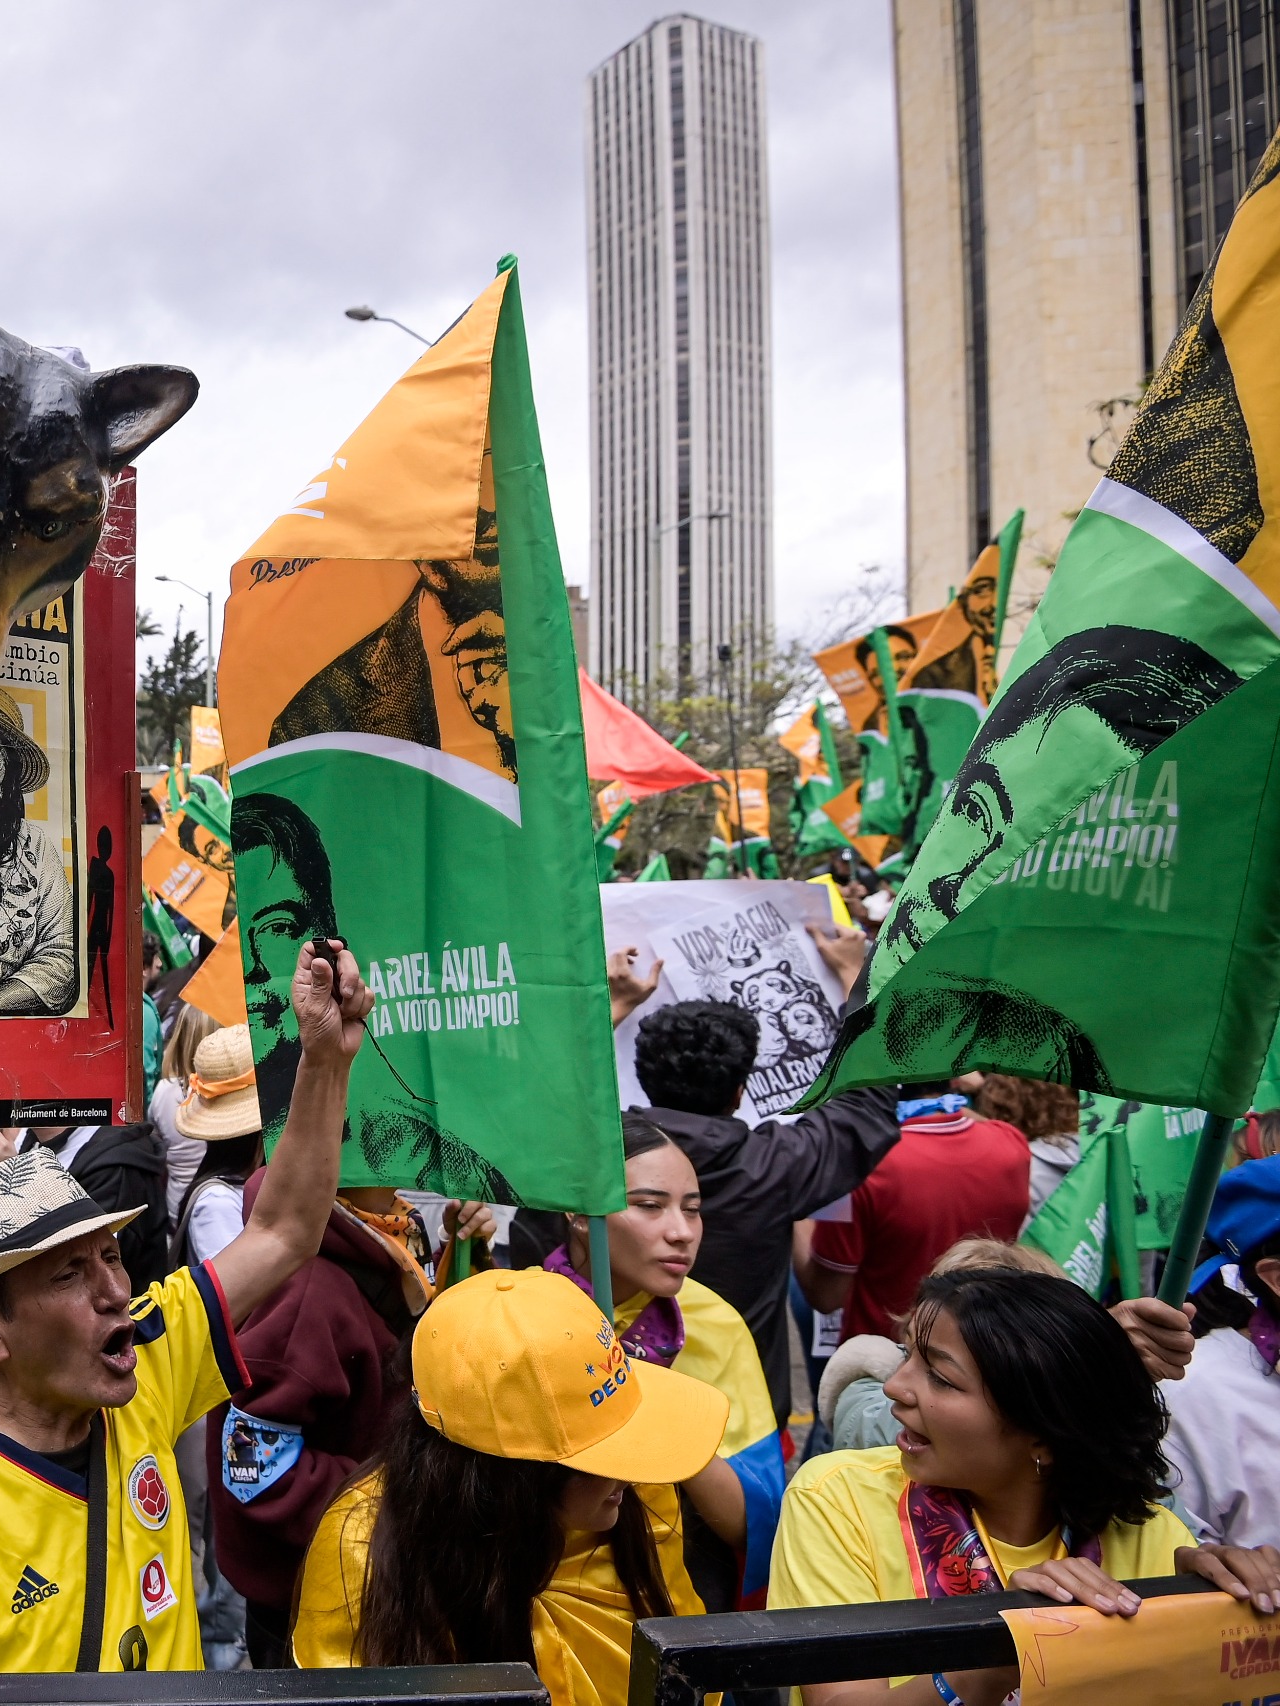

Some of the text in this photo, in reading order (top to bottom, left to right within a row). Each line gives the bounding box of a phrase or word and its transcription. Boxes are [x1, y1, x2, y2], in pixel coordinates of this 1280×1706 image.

[1047, 825, 1178, 872] LIMPIO!
[672, 900, 791, 969] VIDA AGUA
[370, 940, 517, 1000] ARIEL ÁVILA
[396, 998, 442, 1032] VOTO
[444, 990, 520, 1031] LIMPIO!
[766, 1065, 795, 1093] AL
[58, 1108, 69, 1117] de
[71, 1107, 108, 1117] Barcelona
[11, 1582, 60, 1614] adidas
